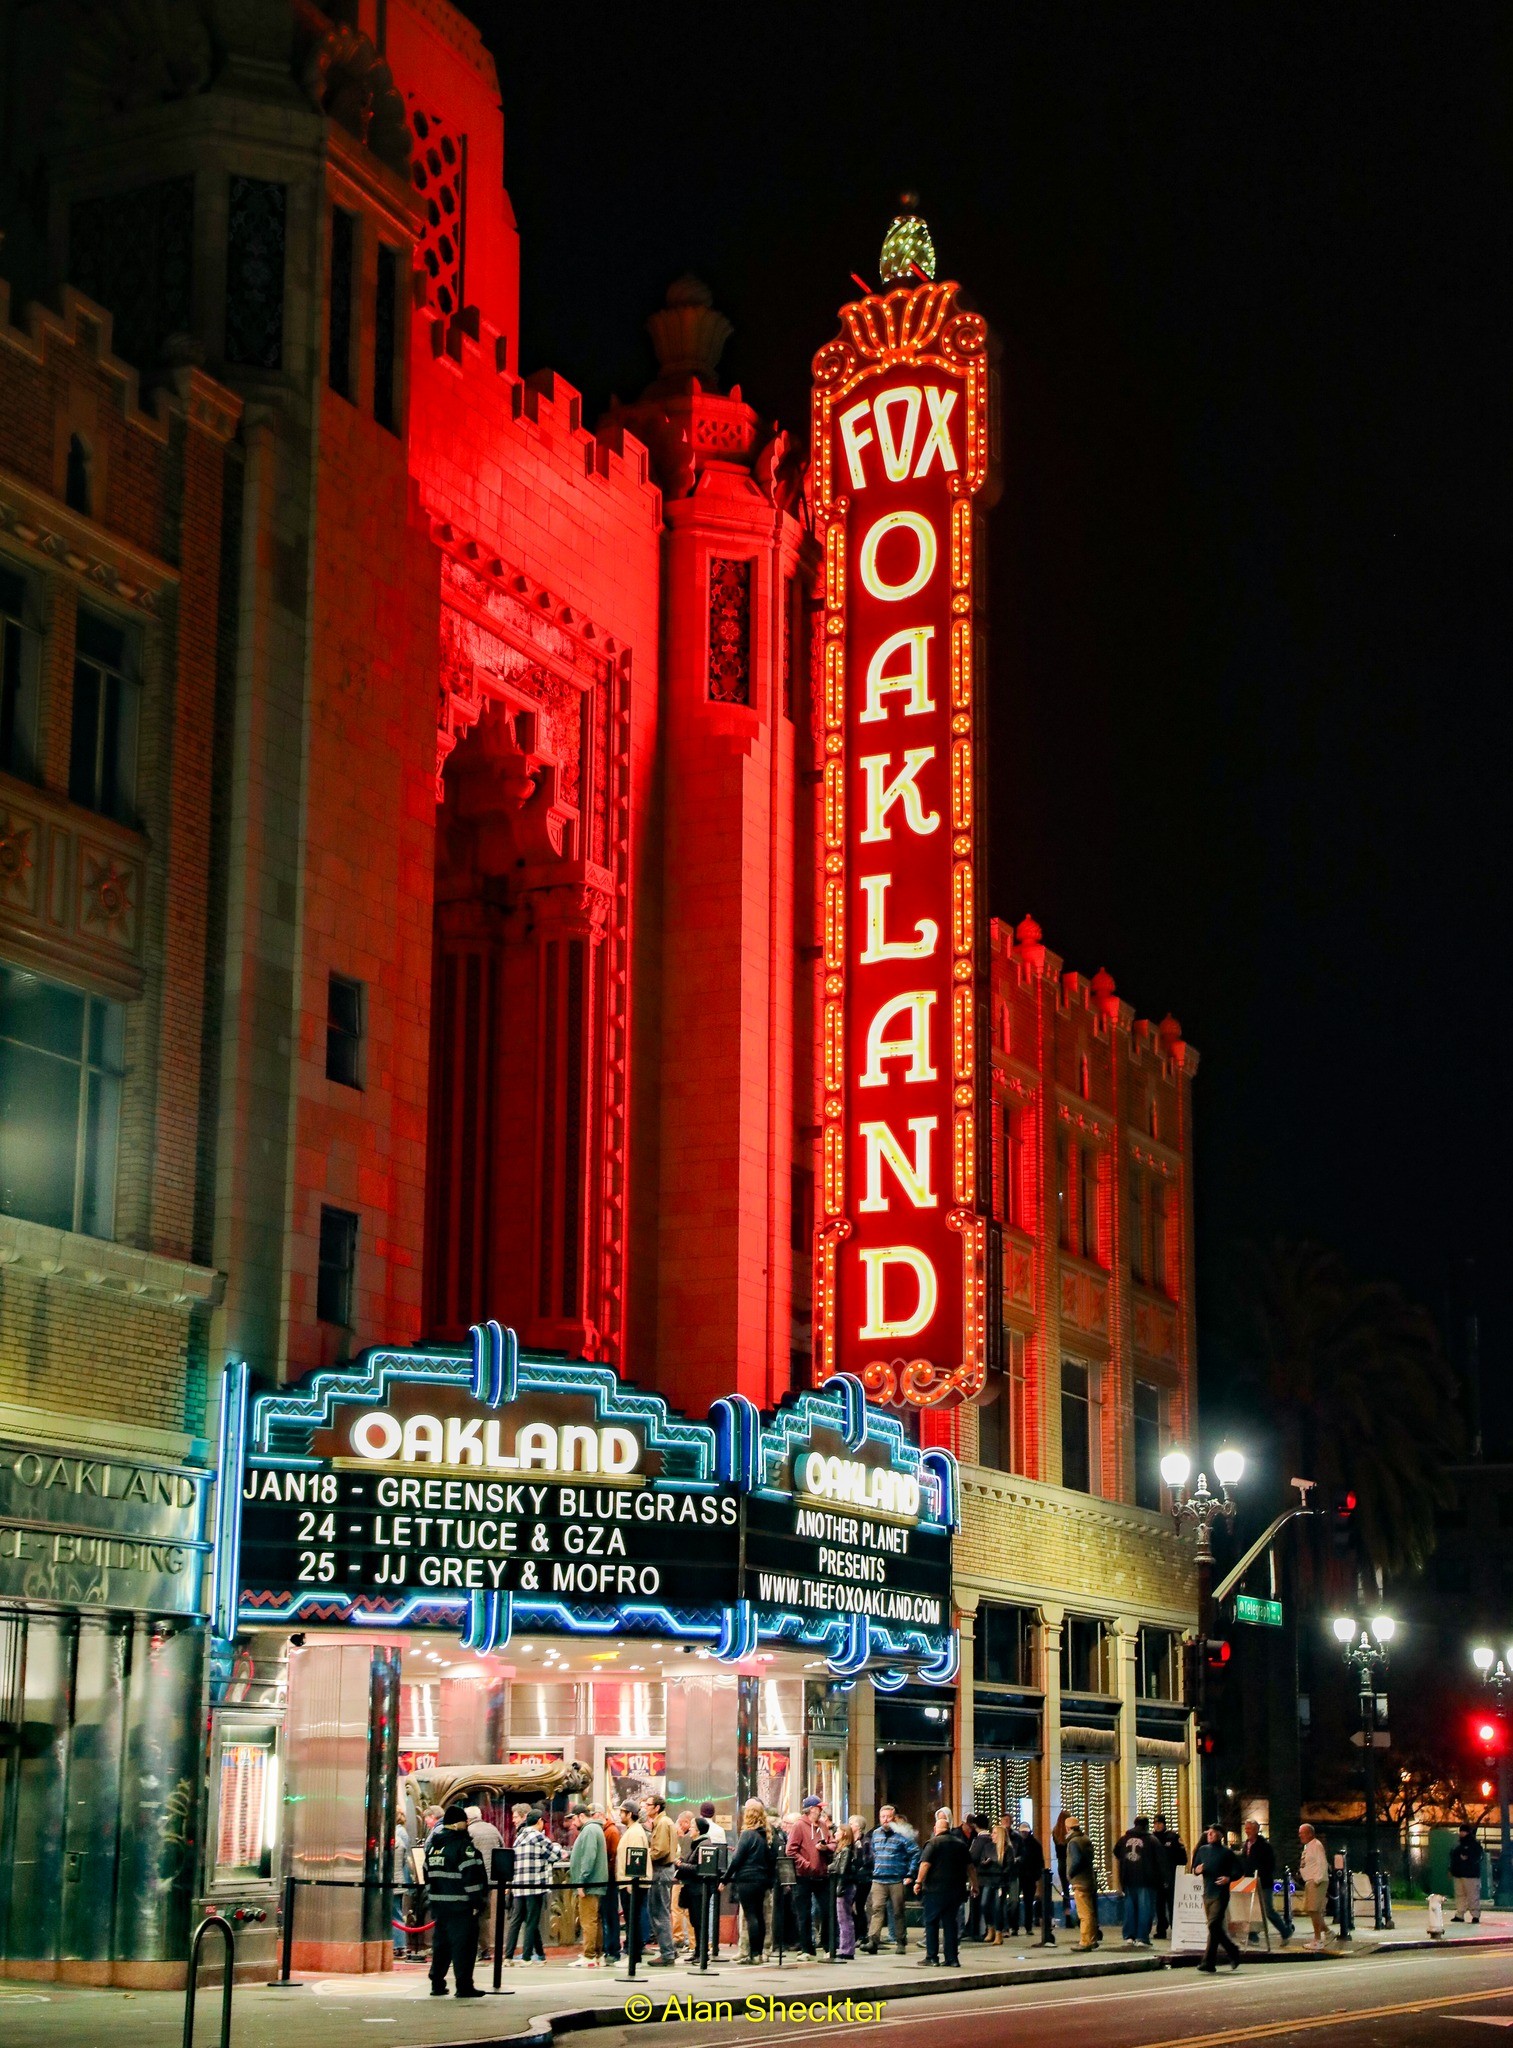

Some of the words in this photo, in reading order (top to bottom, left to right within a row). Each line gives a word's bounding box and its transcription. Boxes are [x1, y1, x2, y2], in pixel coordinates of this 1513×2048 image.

[838, 385, 959, 490] FOX
[859, 510, 940, 1341] OAKLAND
[351, 1411, 640, 1475] OAKLAND
[14, 1453, 197, 1508] OAKLAND
[243, 1470, 338, 1504] JAN18
[377, 1477, 548, 1516] GREENSKY
[559, 1488, 738, 1525] BLUEGRASS
[801, 1451, 920, 1516] OAKLAND
[53, 1533, 184, 1575] BUILDING
[298, 1512, 336, 1543] 24
[375, 1515, 518, 1552] LETTUCE
[531, 1526, 549, 1553] &
[563, 1525, 627, 1556] GZA
[796, 1509, 858, 1546] ANOTHER
[862, 1520, 909, 1554] PLANET
[298, 1551, 336, 1582] 25
[374, 1555, 406, 1585] JJ
[419, 1556, 508, 1588] GREY
[521, 1561, 539, 1591] &
[553, 1563, 660, 1595] MOFRO
[818, 1547, 886, 1583] PRESENTS
[758, 1573, 940, 1626] WWW.THEFOXOAKLAND.COM
[1244, 1600, 1270, 1621] Telegraph
[629, 1755, 649, 1770] FOX
